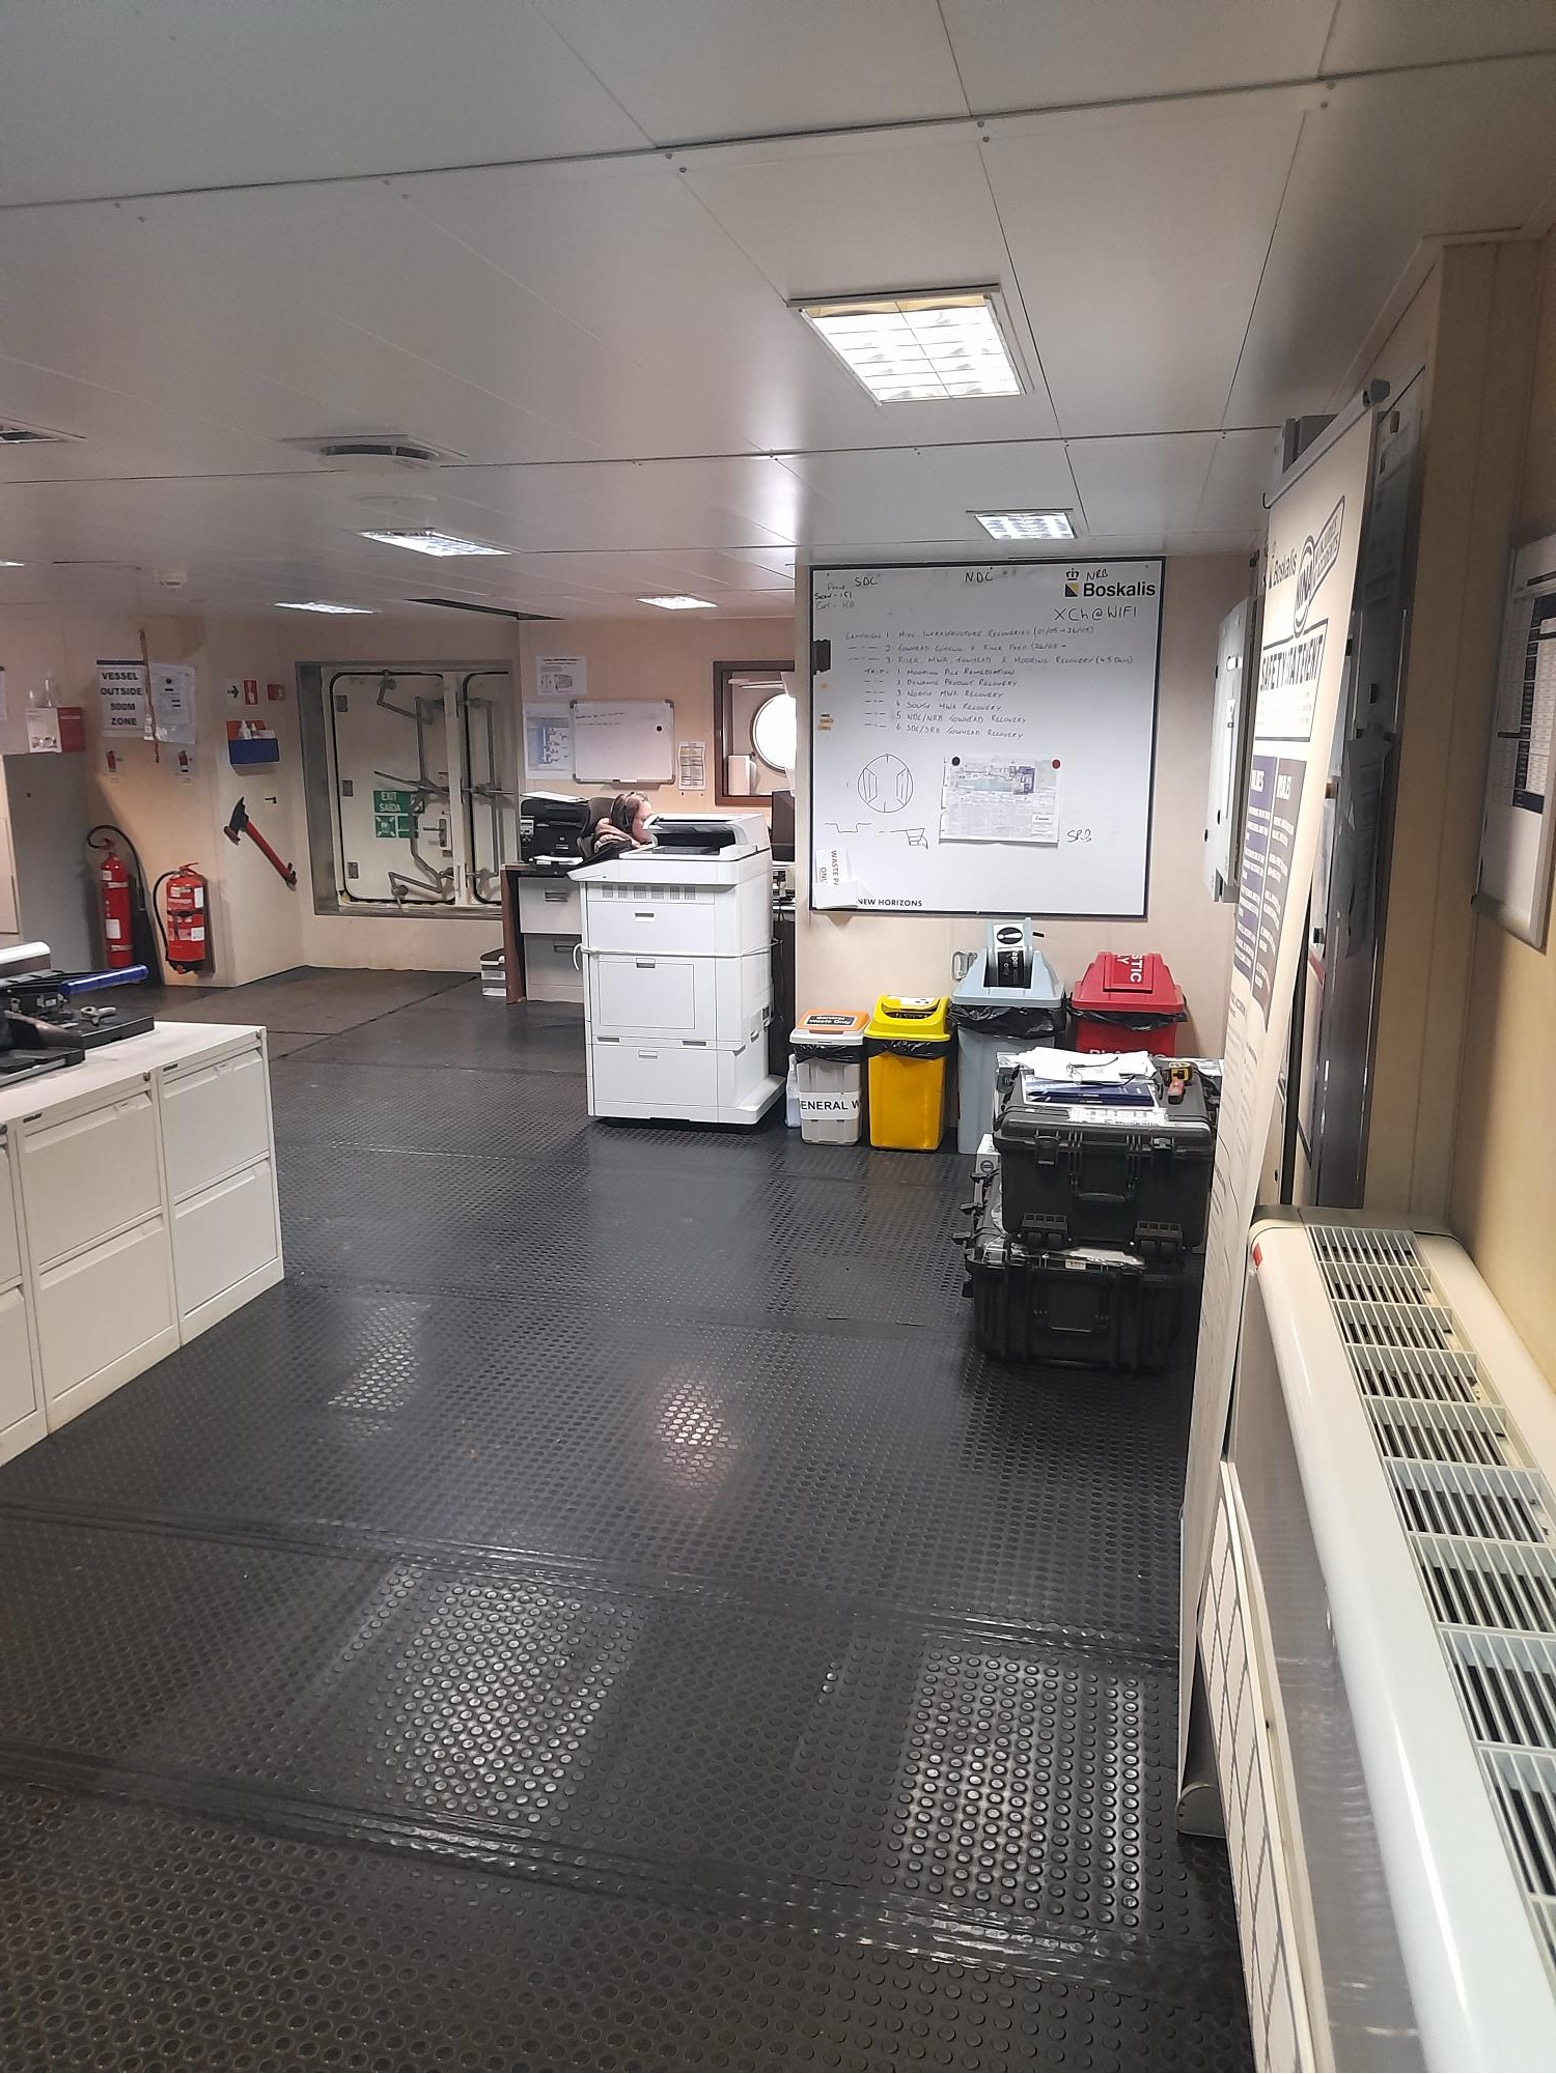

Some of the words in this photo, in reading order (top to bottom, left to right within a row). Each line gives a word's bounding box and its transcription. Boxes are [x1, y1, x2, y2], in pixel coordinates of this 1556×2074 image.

[854, 576, 878, 587] SDC
[964, 571, 994, 584] NDC
[1083, 581, 1156, 597] Boskalis
[101, 672, 139, 681] VESSEL
[100, 687, 144, 696] OUTSIDE
[111, 717, 138, 726] ZONE
[381, 791, 397, 801] EXIT
[830, 850, 839, 876] WASTE
[819, 866, 828, 884] ONL
[878, 899, 923, 907] HORIZONS
[801, 1100, 849, 1111] ENERAL
